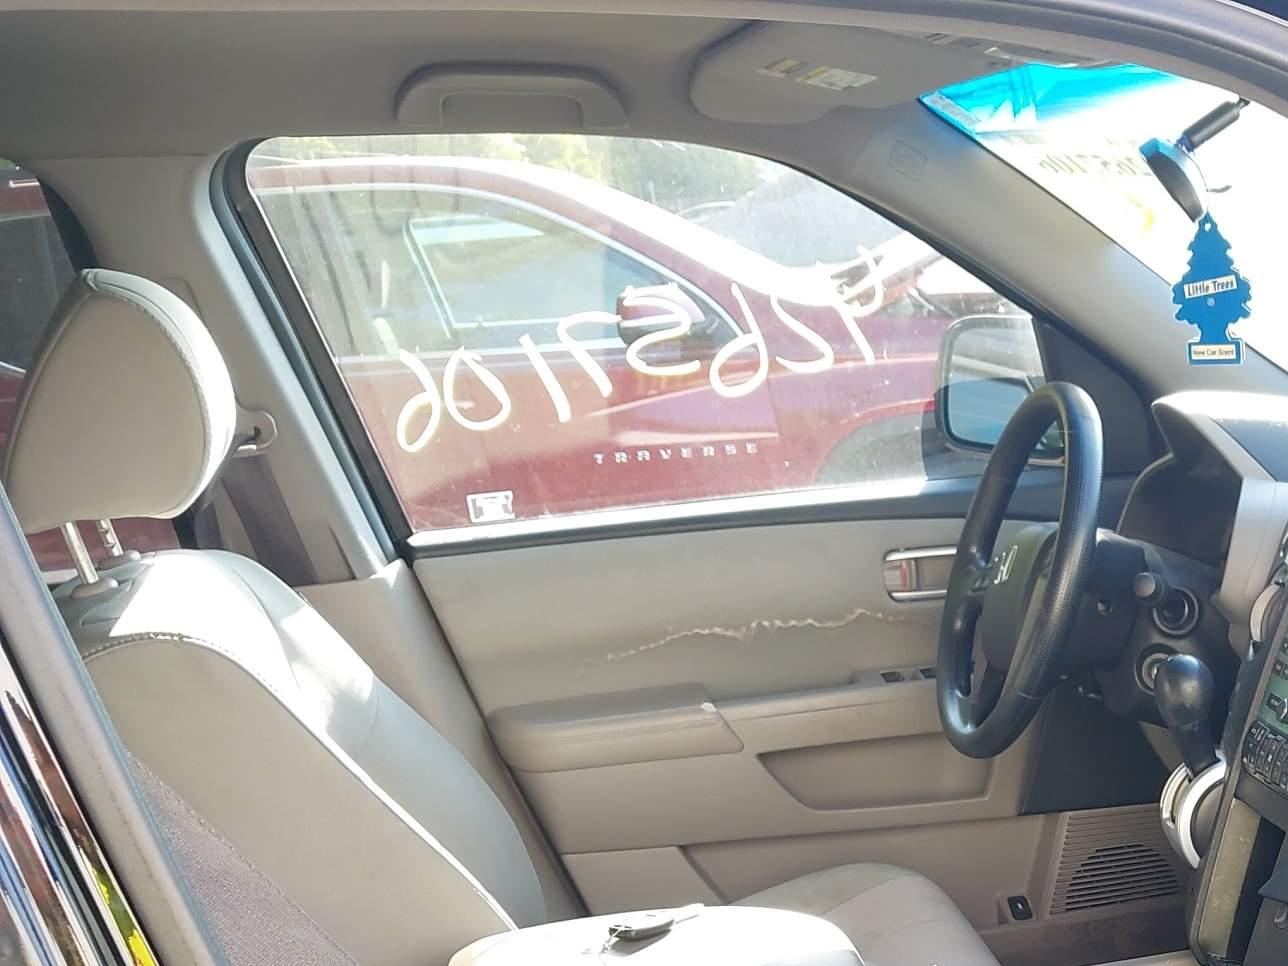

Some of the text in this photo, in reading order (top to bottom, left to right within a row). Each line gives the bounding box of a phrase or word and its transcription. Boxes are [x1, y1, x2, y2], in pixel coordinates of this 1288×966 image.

[1186, 279, 1235, 297] Little Trees
[1206, 348, 1217, 356] Car
[592, 442, 758, 464] TRAVERSE
